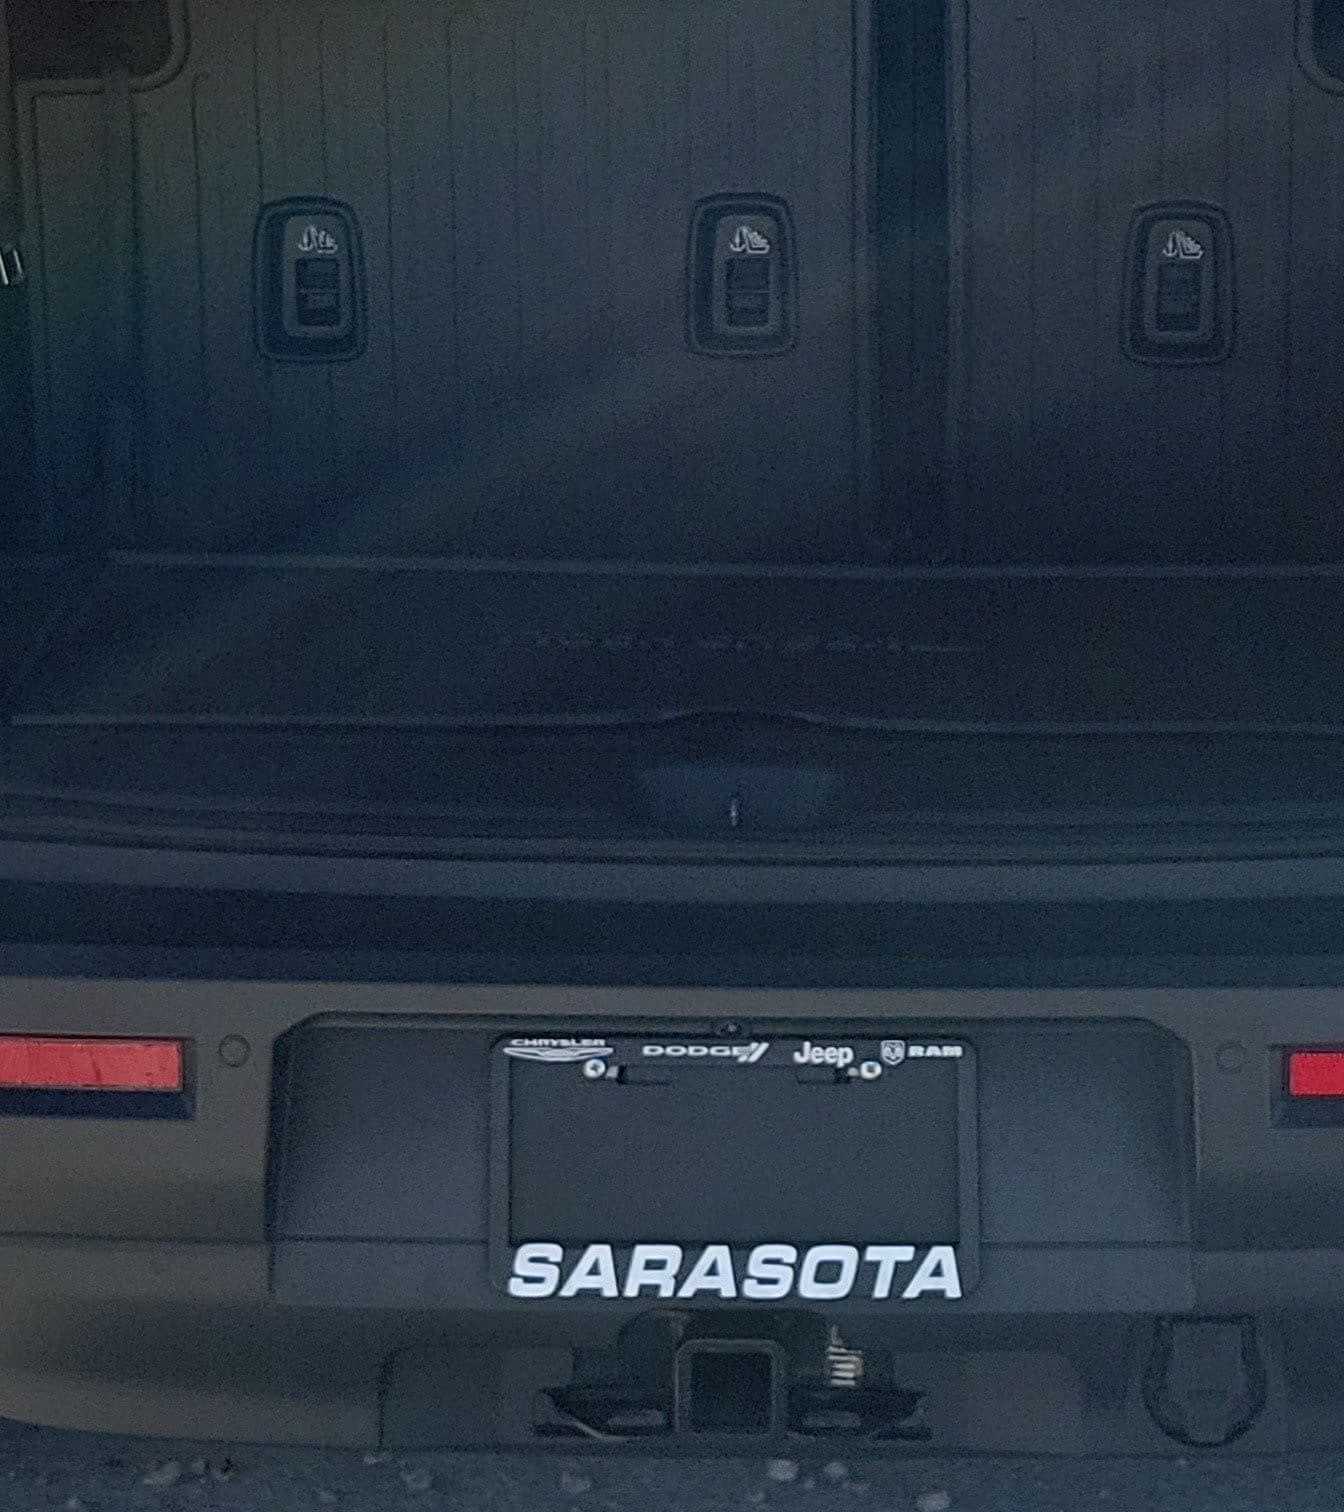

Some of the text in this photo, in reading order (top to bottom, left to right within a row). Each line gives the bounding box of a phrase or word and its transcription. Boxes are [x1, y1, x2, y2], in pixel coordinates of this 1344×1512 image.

[793, 1040, 855, 1069] Jeep
[907, 1045, 963, 1058] RAM
[507, 1242, 964, 1300] SARASOTA
